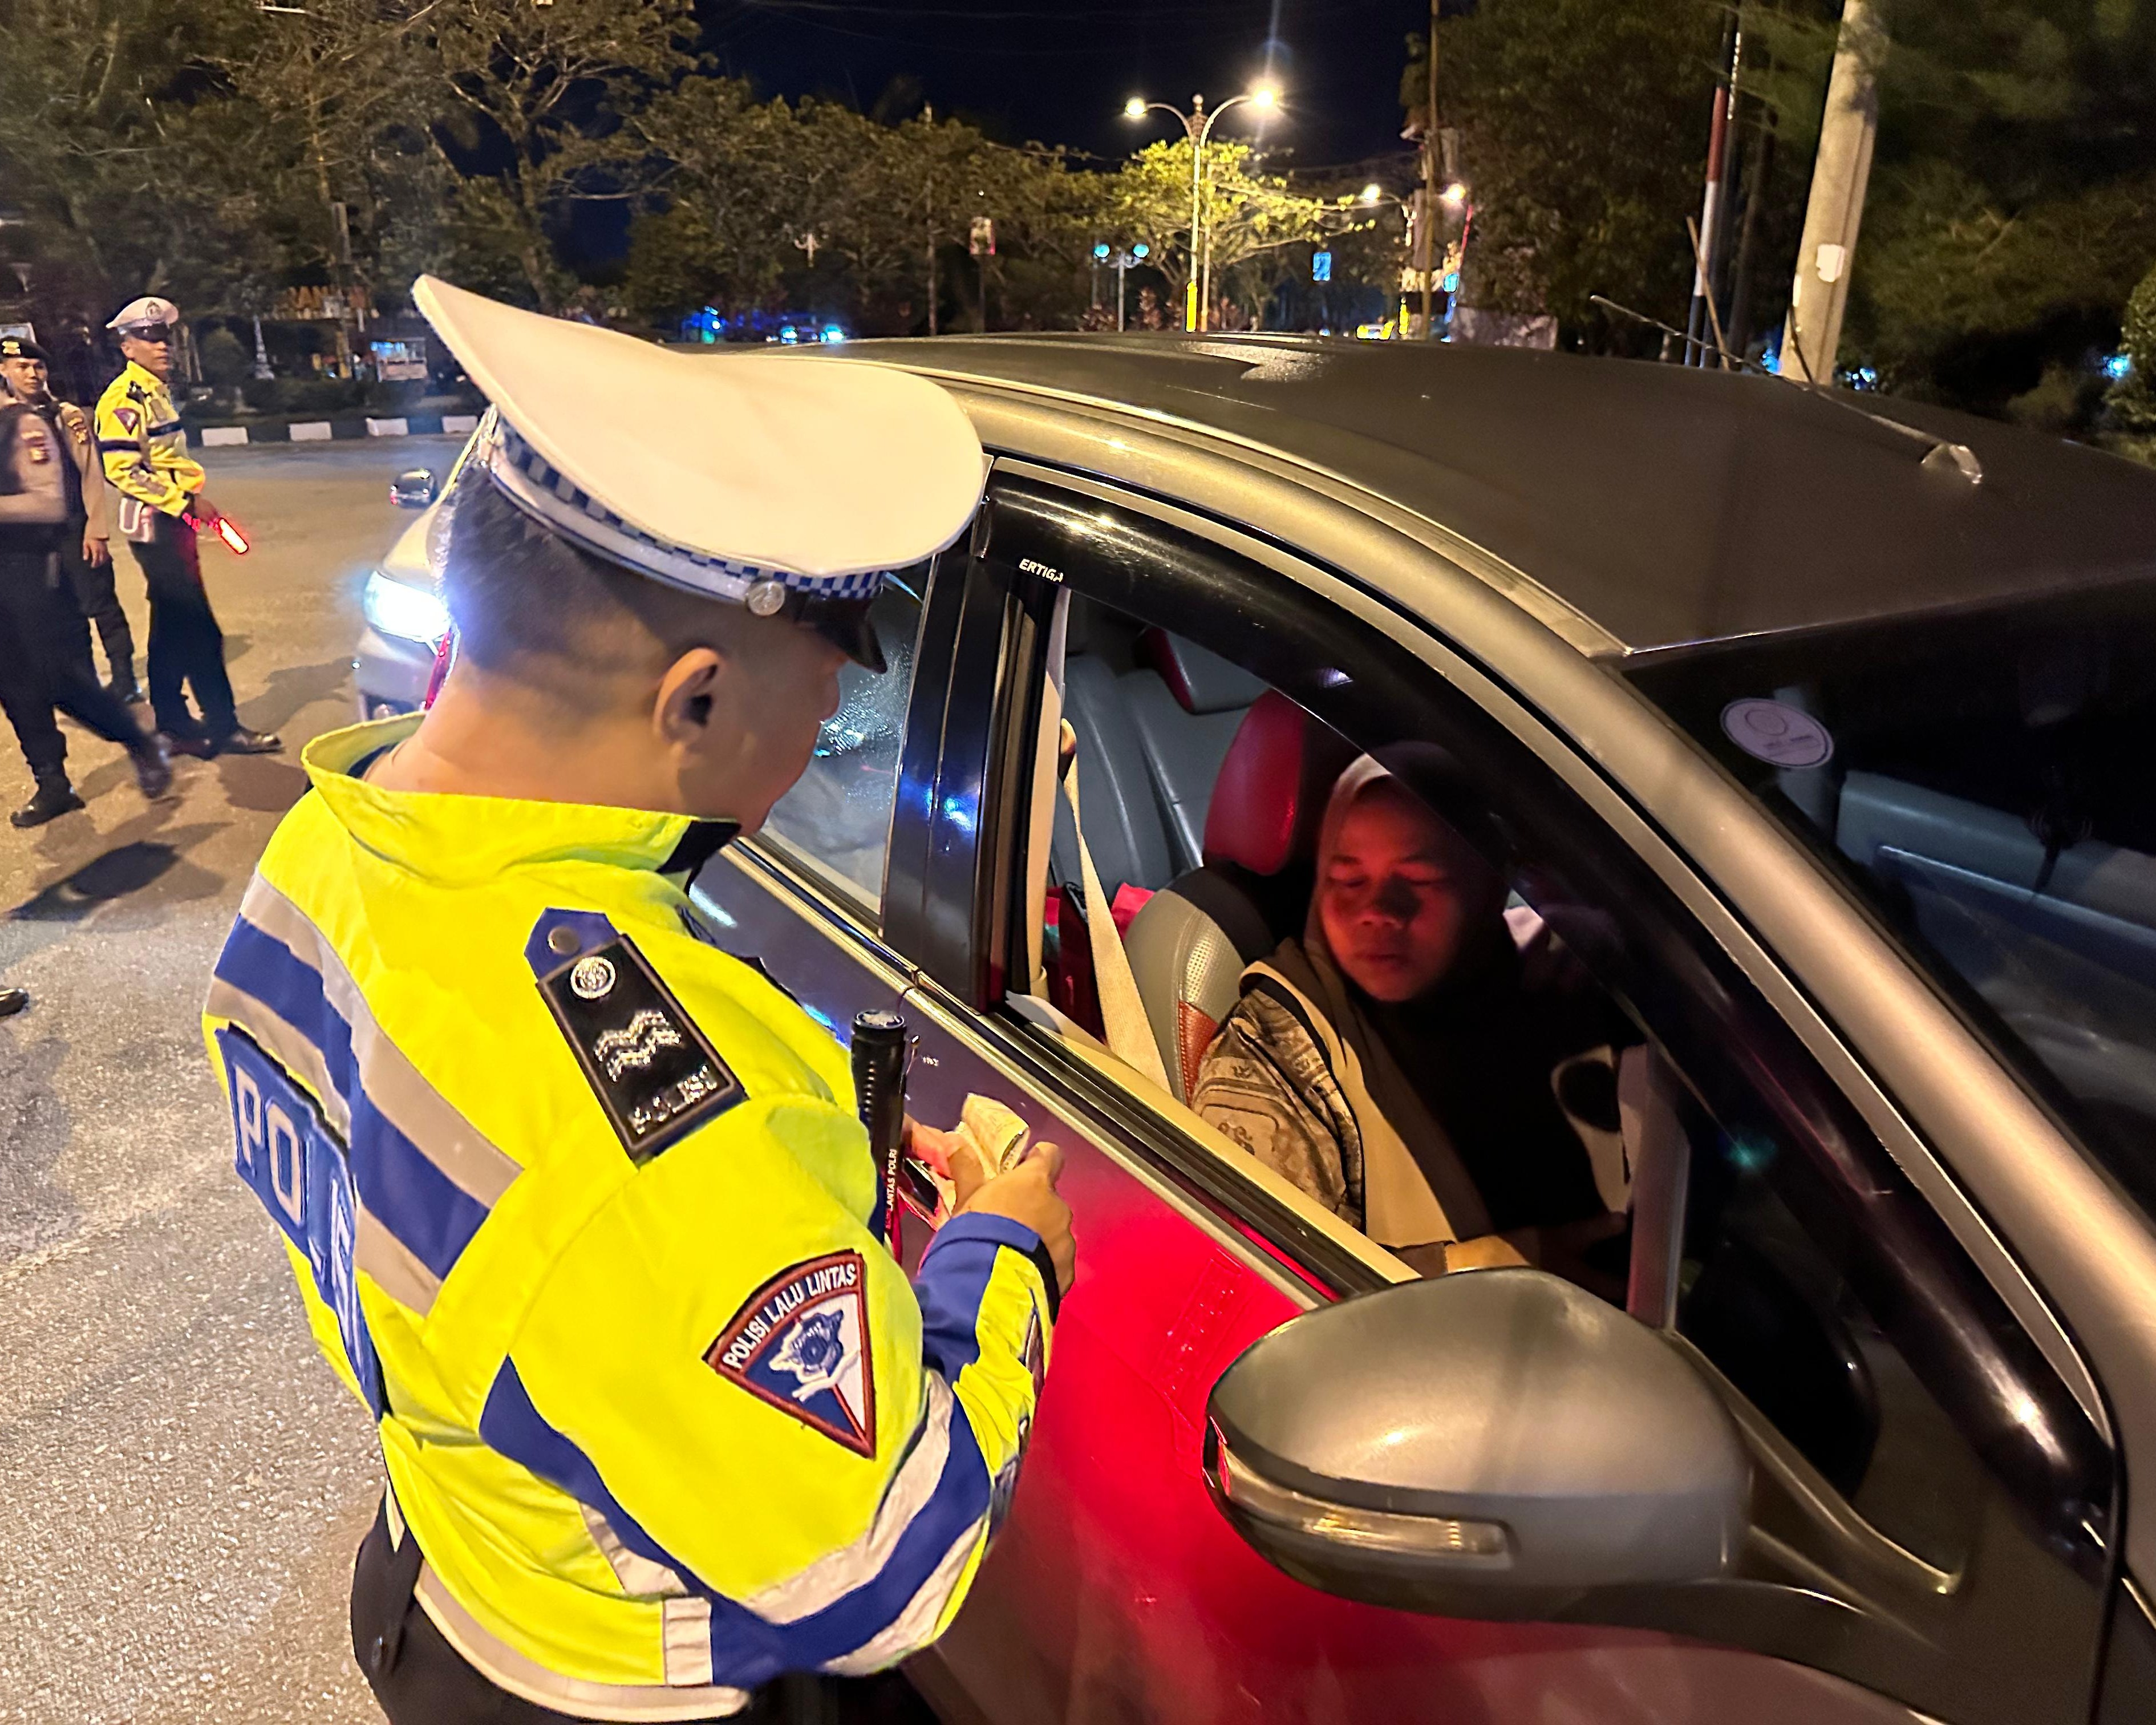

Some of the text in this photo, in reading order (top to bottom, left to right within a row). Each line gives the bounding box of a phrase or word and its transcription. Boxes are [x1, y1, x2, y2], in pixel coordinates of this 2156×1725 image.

[1019, 558, 1064, 582] ERTIGA
[722, 1263, 857, 1368] POLISI LALU LINTAS
